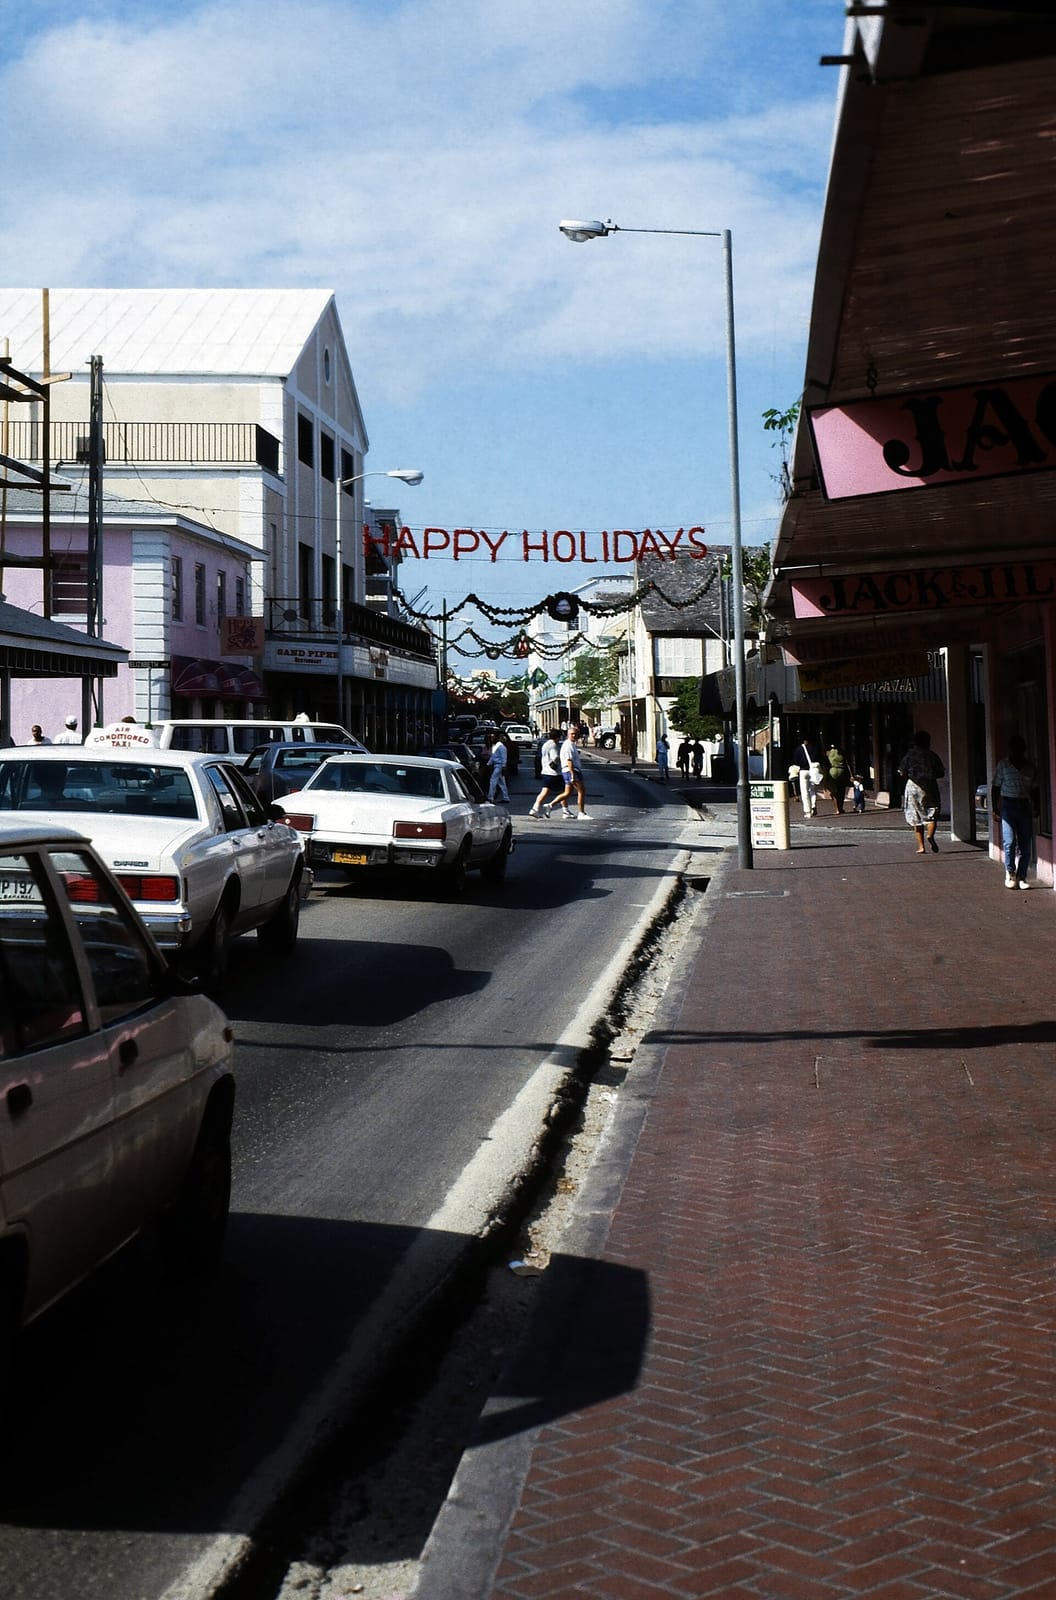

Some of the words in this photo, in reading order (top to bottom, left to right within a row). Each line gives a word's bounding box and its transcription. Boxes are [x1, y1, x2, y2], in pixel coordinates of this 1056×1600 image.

[363, 524, 509, 562] HAPPY
[522, 526, 707, 563] HOLIDAYS
[820, 570, 948, 611] JACK
[967, 564, 1056, 600] JIL
[277, 649, 305, 657] SAND
[94, 733, 150, 744] CONDITIONED
